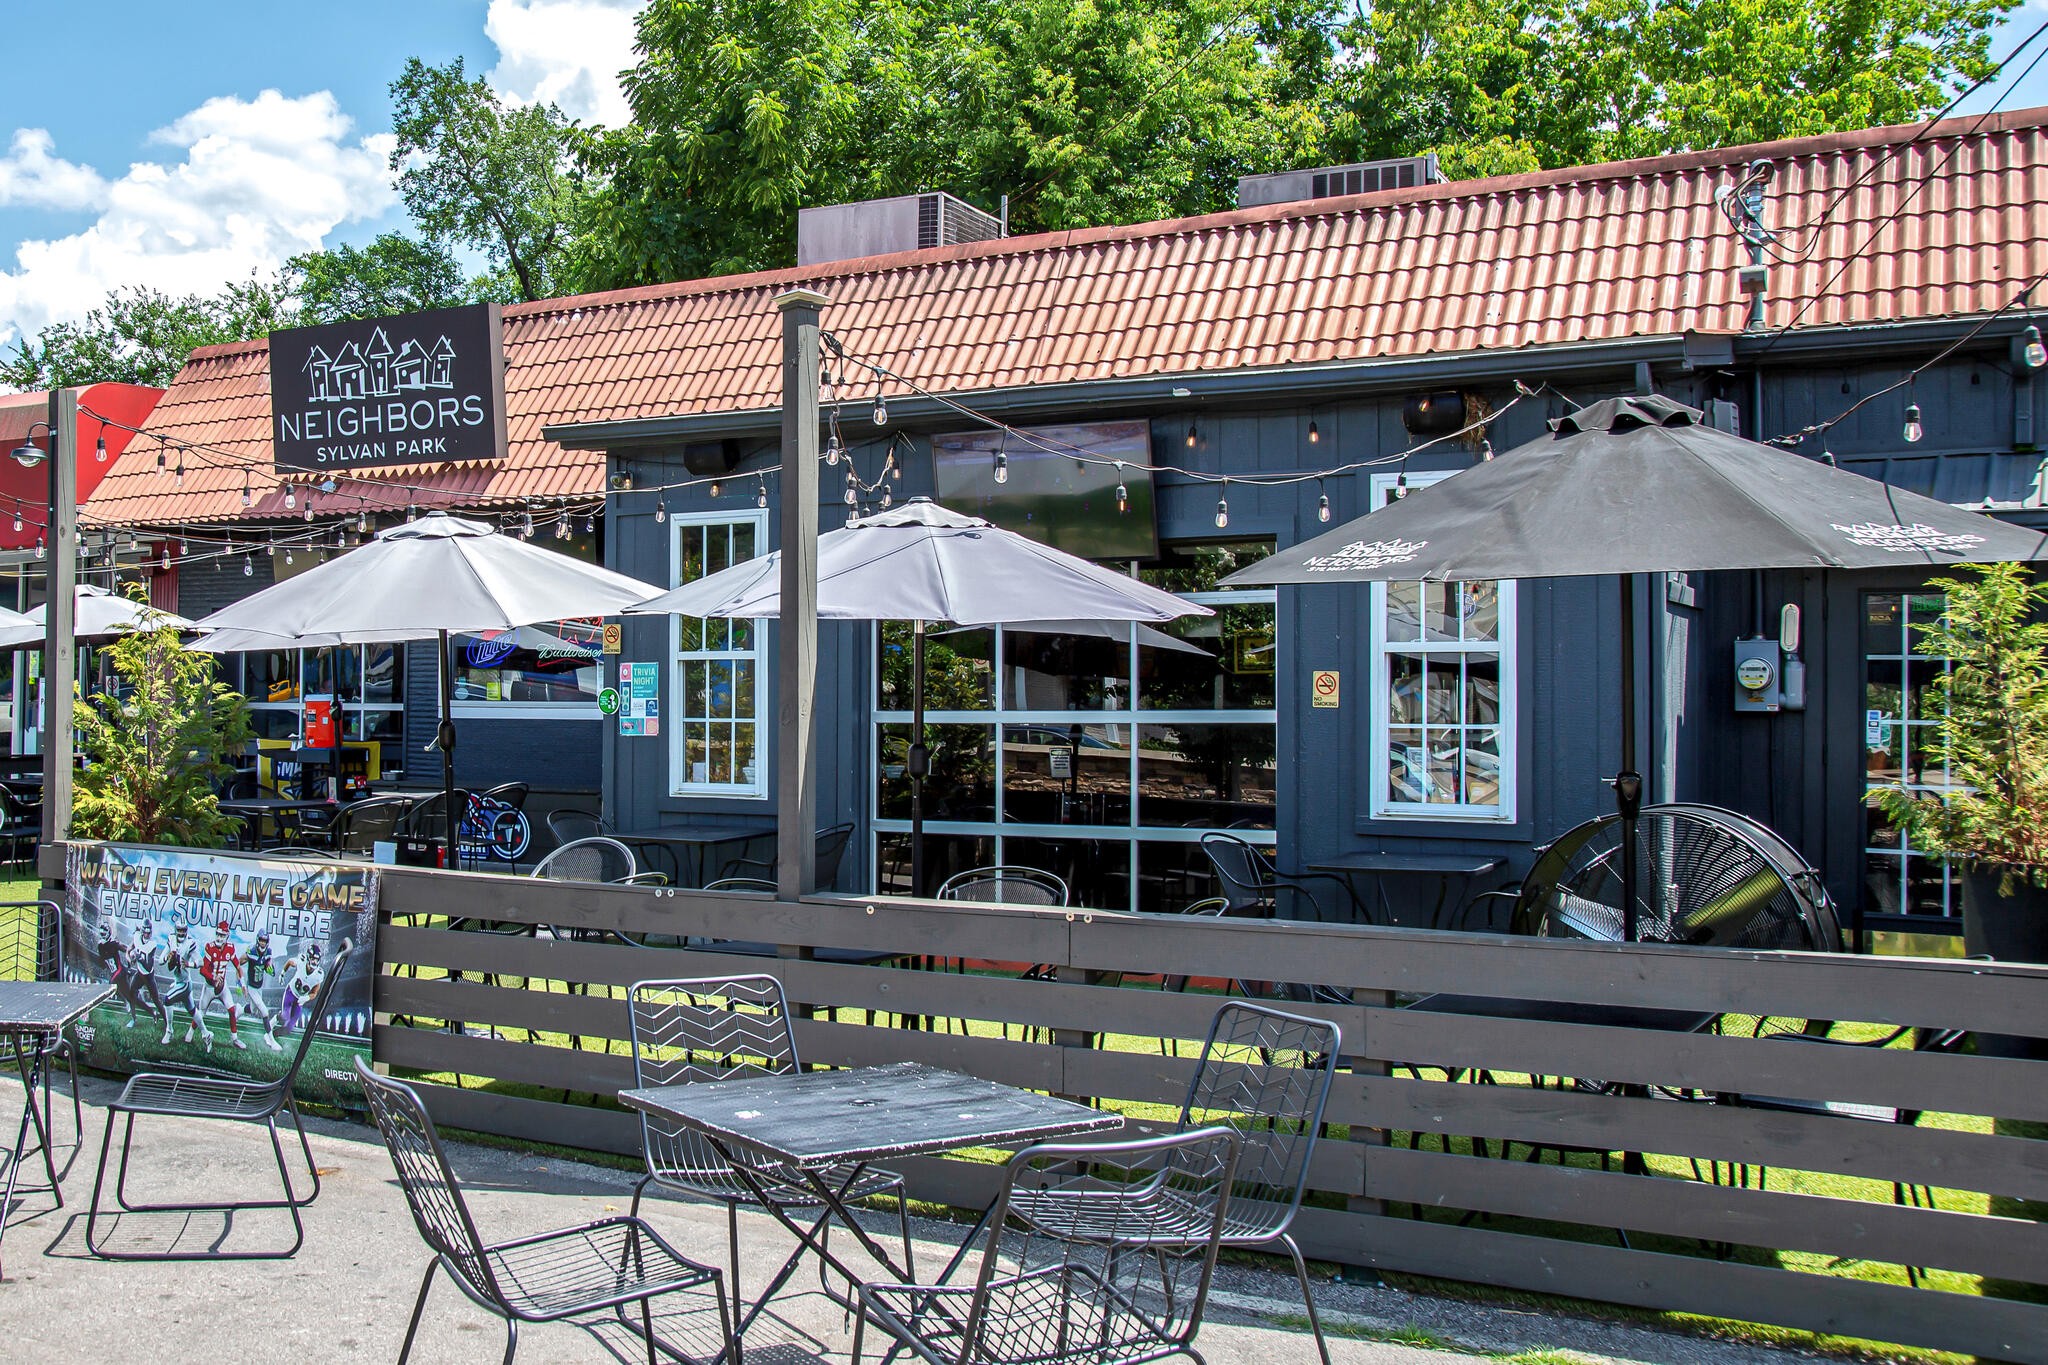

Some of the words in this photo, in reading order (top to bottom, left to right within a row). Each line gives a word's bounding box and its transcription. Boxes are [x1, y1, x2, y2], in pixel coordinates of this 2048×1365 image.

[281, 395, 485, 442] NEIGHBORS
[317, 442, 386, 463] SYLVAN
[396, 437, 447, 456] PARK
[1845, 534, 1986, 546] NEIGHBORS
[1303, 554, 1417, 566] NEIGHBORS
[536, 642, 603, 659] Budweiser
[634, 668, 656, 676] TRIVIA
[634, 677, 655, 685] NIGHT
[79, 861, 151, 891] WATCH
[154, 868, 228, 899] EVERY
[234, 875, 288, 906] LIVE
[291, 882, 367, 912] GAME
[100, 890, 168, 921] EVERY
[172, 897, 261, 932] SUNDAY
[267, 906, 333, 940] HERE
[74, 1023, 97, 1034] SUNDAY
[76, 1030, 95, 1041] TICKET
[324, 1068, 358, 1082] DIRECTV
